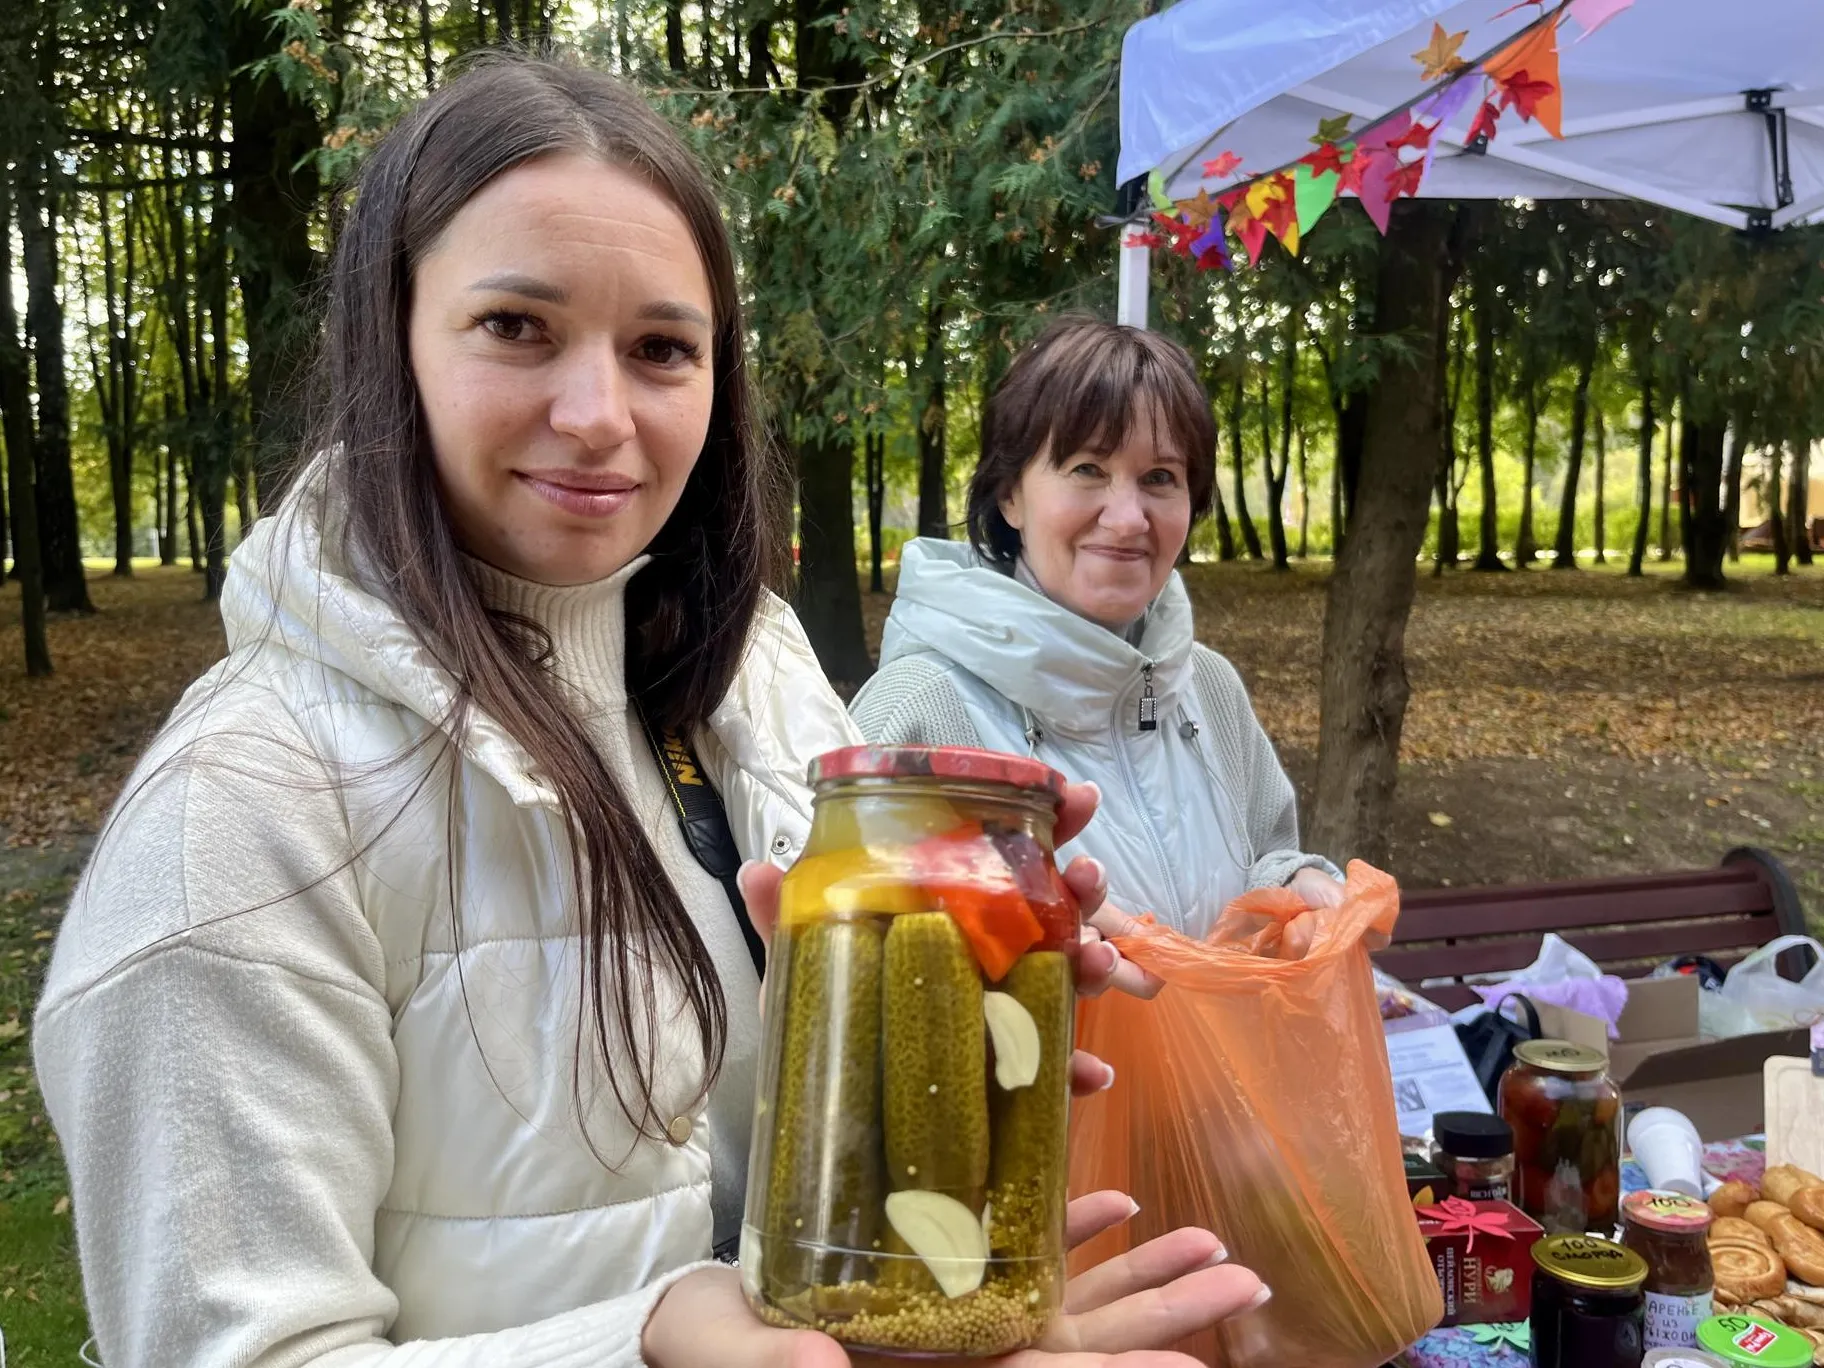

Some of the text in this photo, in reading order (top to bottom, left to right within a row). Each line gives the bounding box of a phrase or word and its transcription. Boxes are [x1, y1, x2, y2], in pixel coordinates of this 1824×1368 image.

[1561, 1239, 1598, 1251] 100
[1463, 1257, 1477, 1304] НУРИ
[1718, 1317, 1751, 1333] 50
